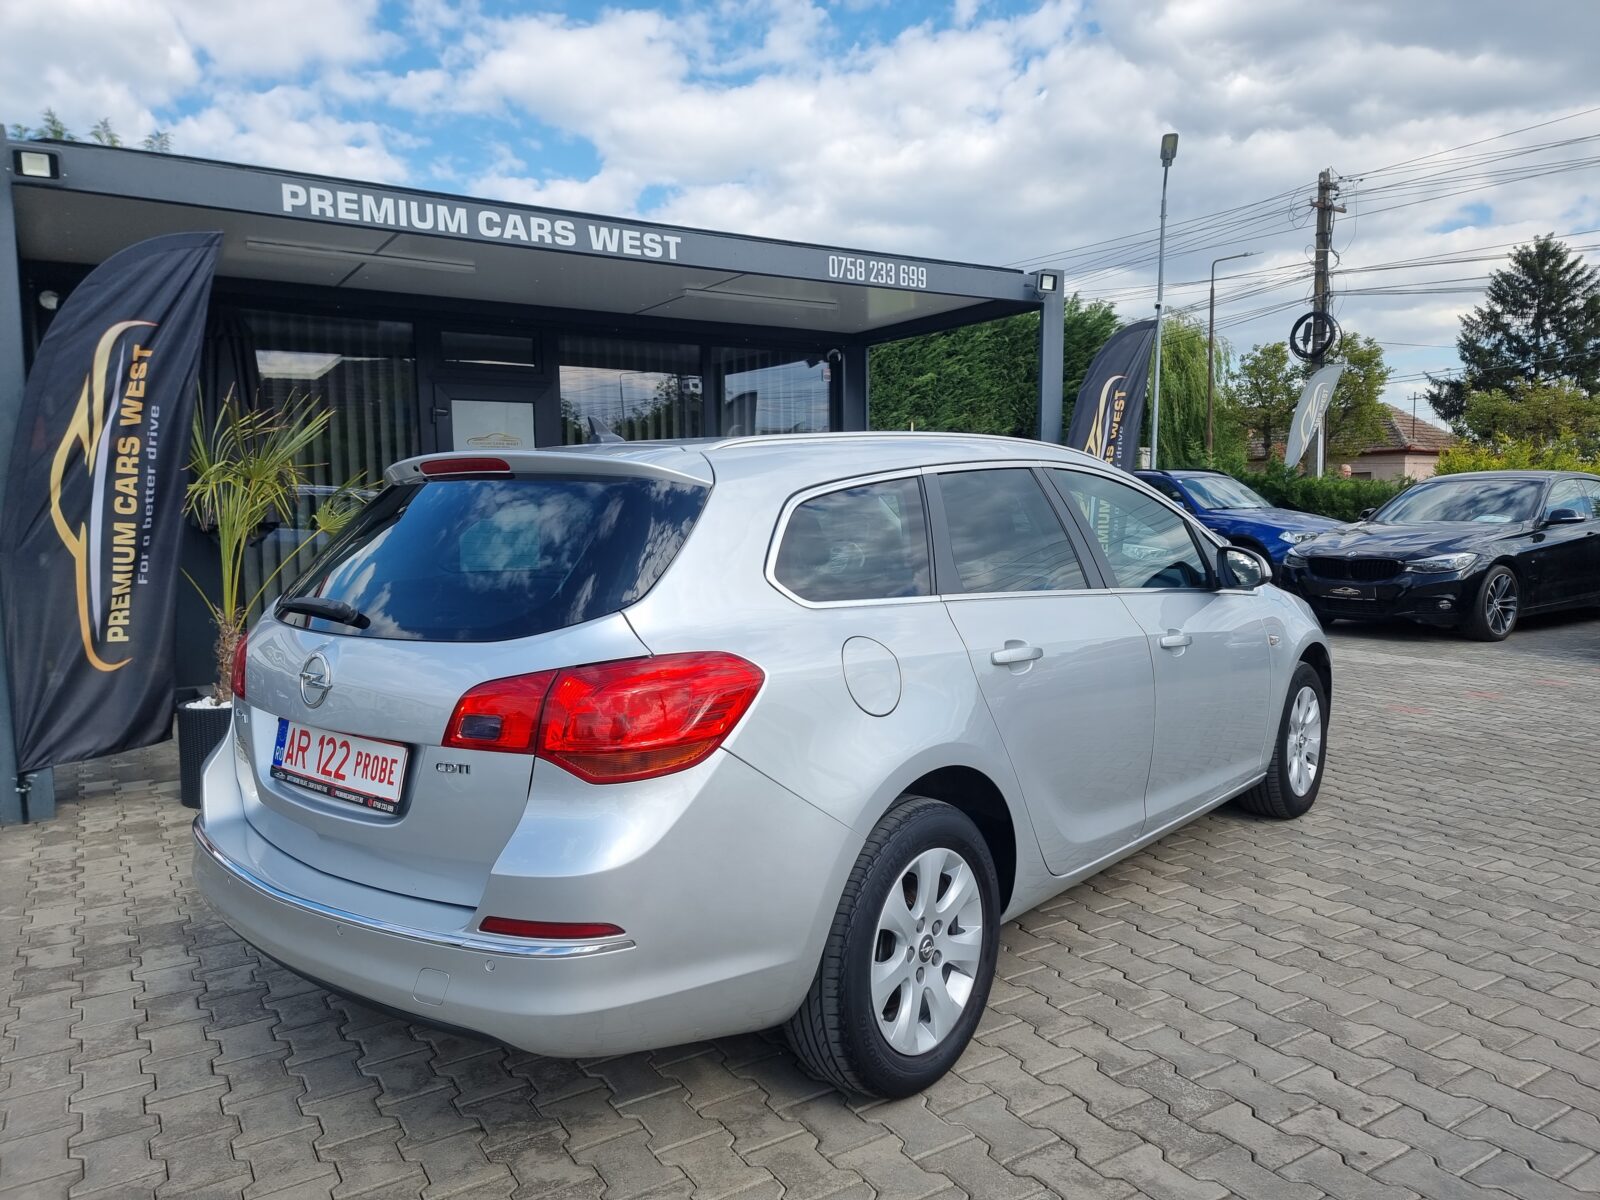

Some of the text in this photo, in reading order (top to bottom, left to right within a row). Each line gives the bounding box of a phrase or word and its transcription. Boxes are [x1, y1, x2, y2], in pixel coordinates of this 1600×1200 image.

[281, 182, 682, 260] PREMIUM CARS WEST
[828, 255, 927, 289] 0758 233 699
[1110, 390, 1127, 439] WEST
[1116, 426, 1124, 459] drive
[107, 344, 153, 643] PREMIUM CARS WEST
[138, 404, 161, 584] For a better drive
[275, 745, 284, 761] RO
[284, 727, 312, 769] AR
[316, 735, 351, 782] 122
[354, 750, 398, 786] PROBE
[435, 761, 471, 775] CDTI
